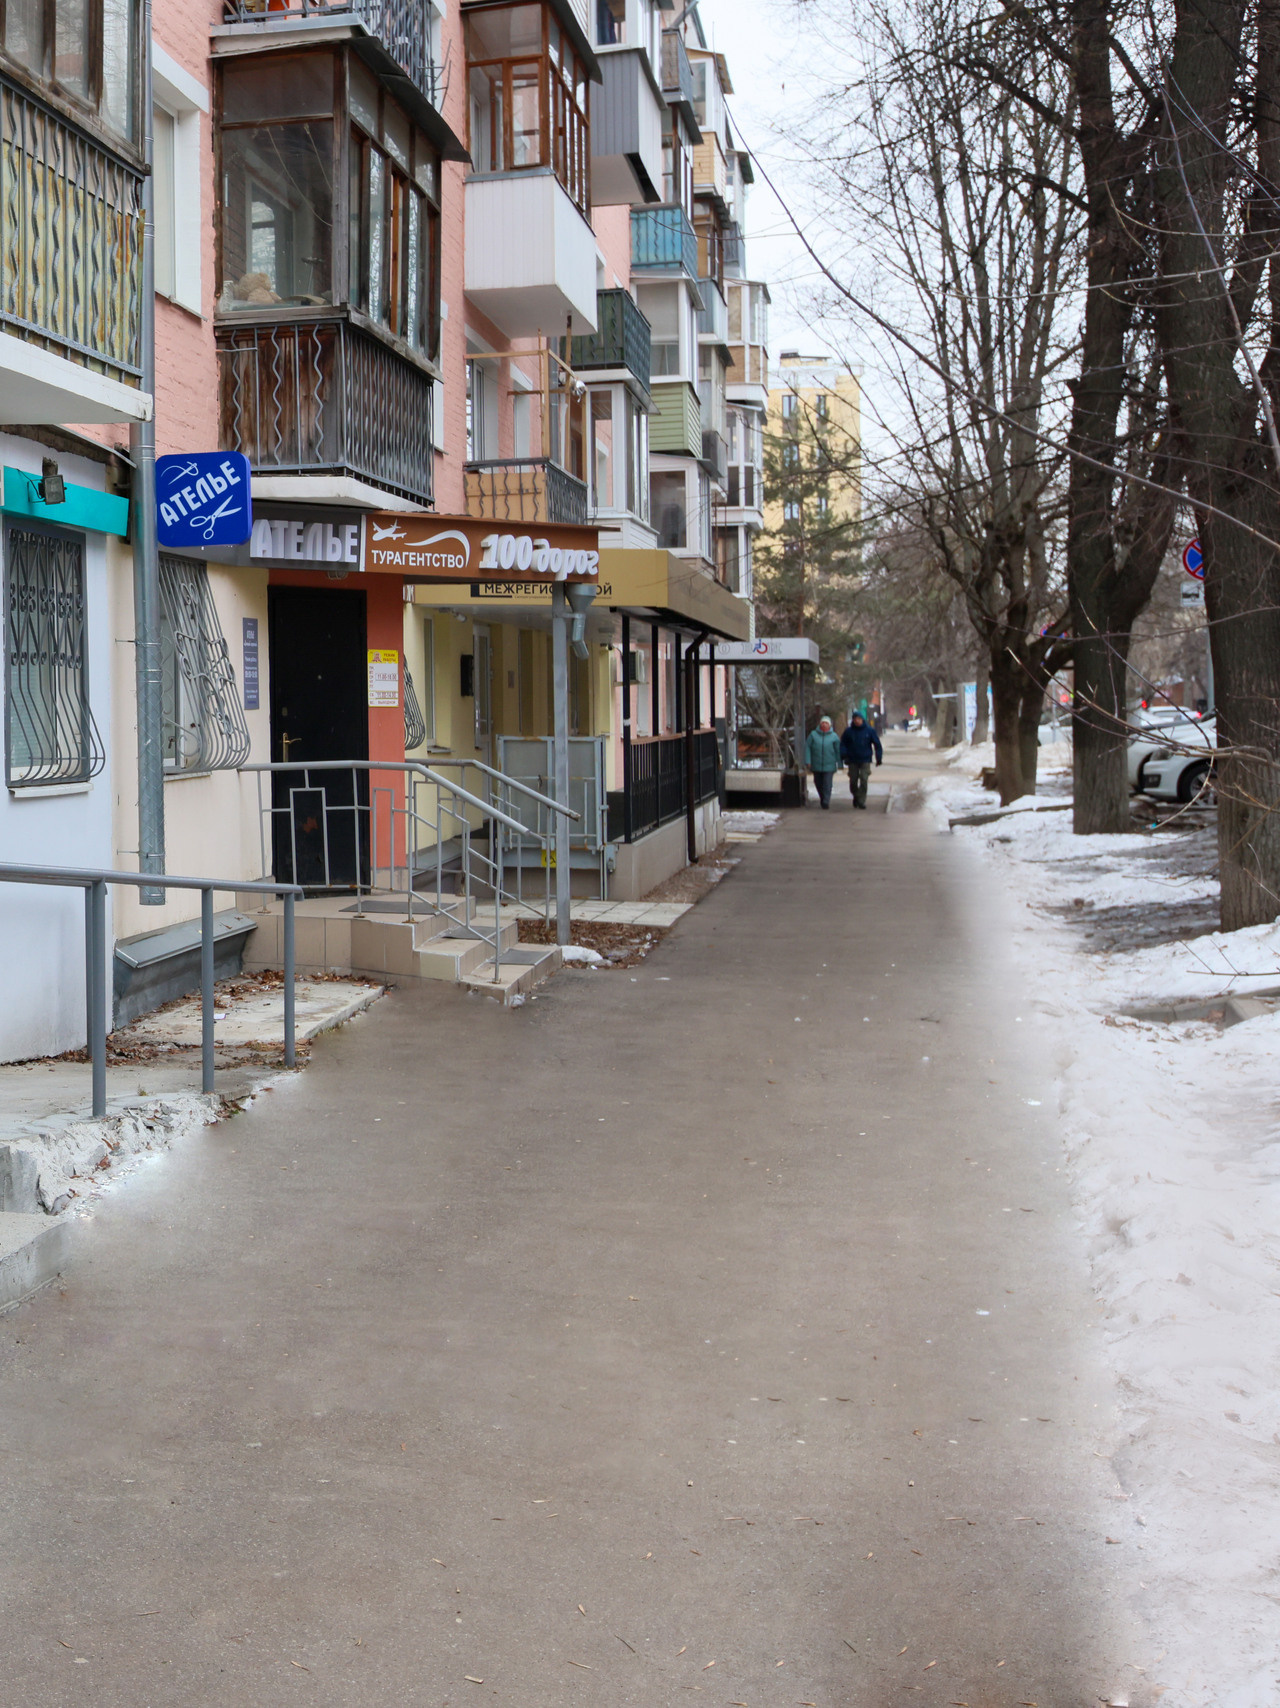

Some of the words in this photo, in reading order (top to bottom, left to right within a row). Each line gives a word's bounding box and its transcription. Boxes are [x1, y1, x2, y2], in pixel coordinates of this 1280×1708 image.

[159, 460, 241, 527] АТЕЛЬЕ
[249, 518, 358, 564] АТЕЛЬЕ
[371, 549, 465, 569] ТУРАГЕНТСТВО
